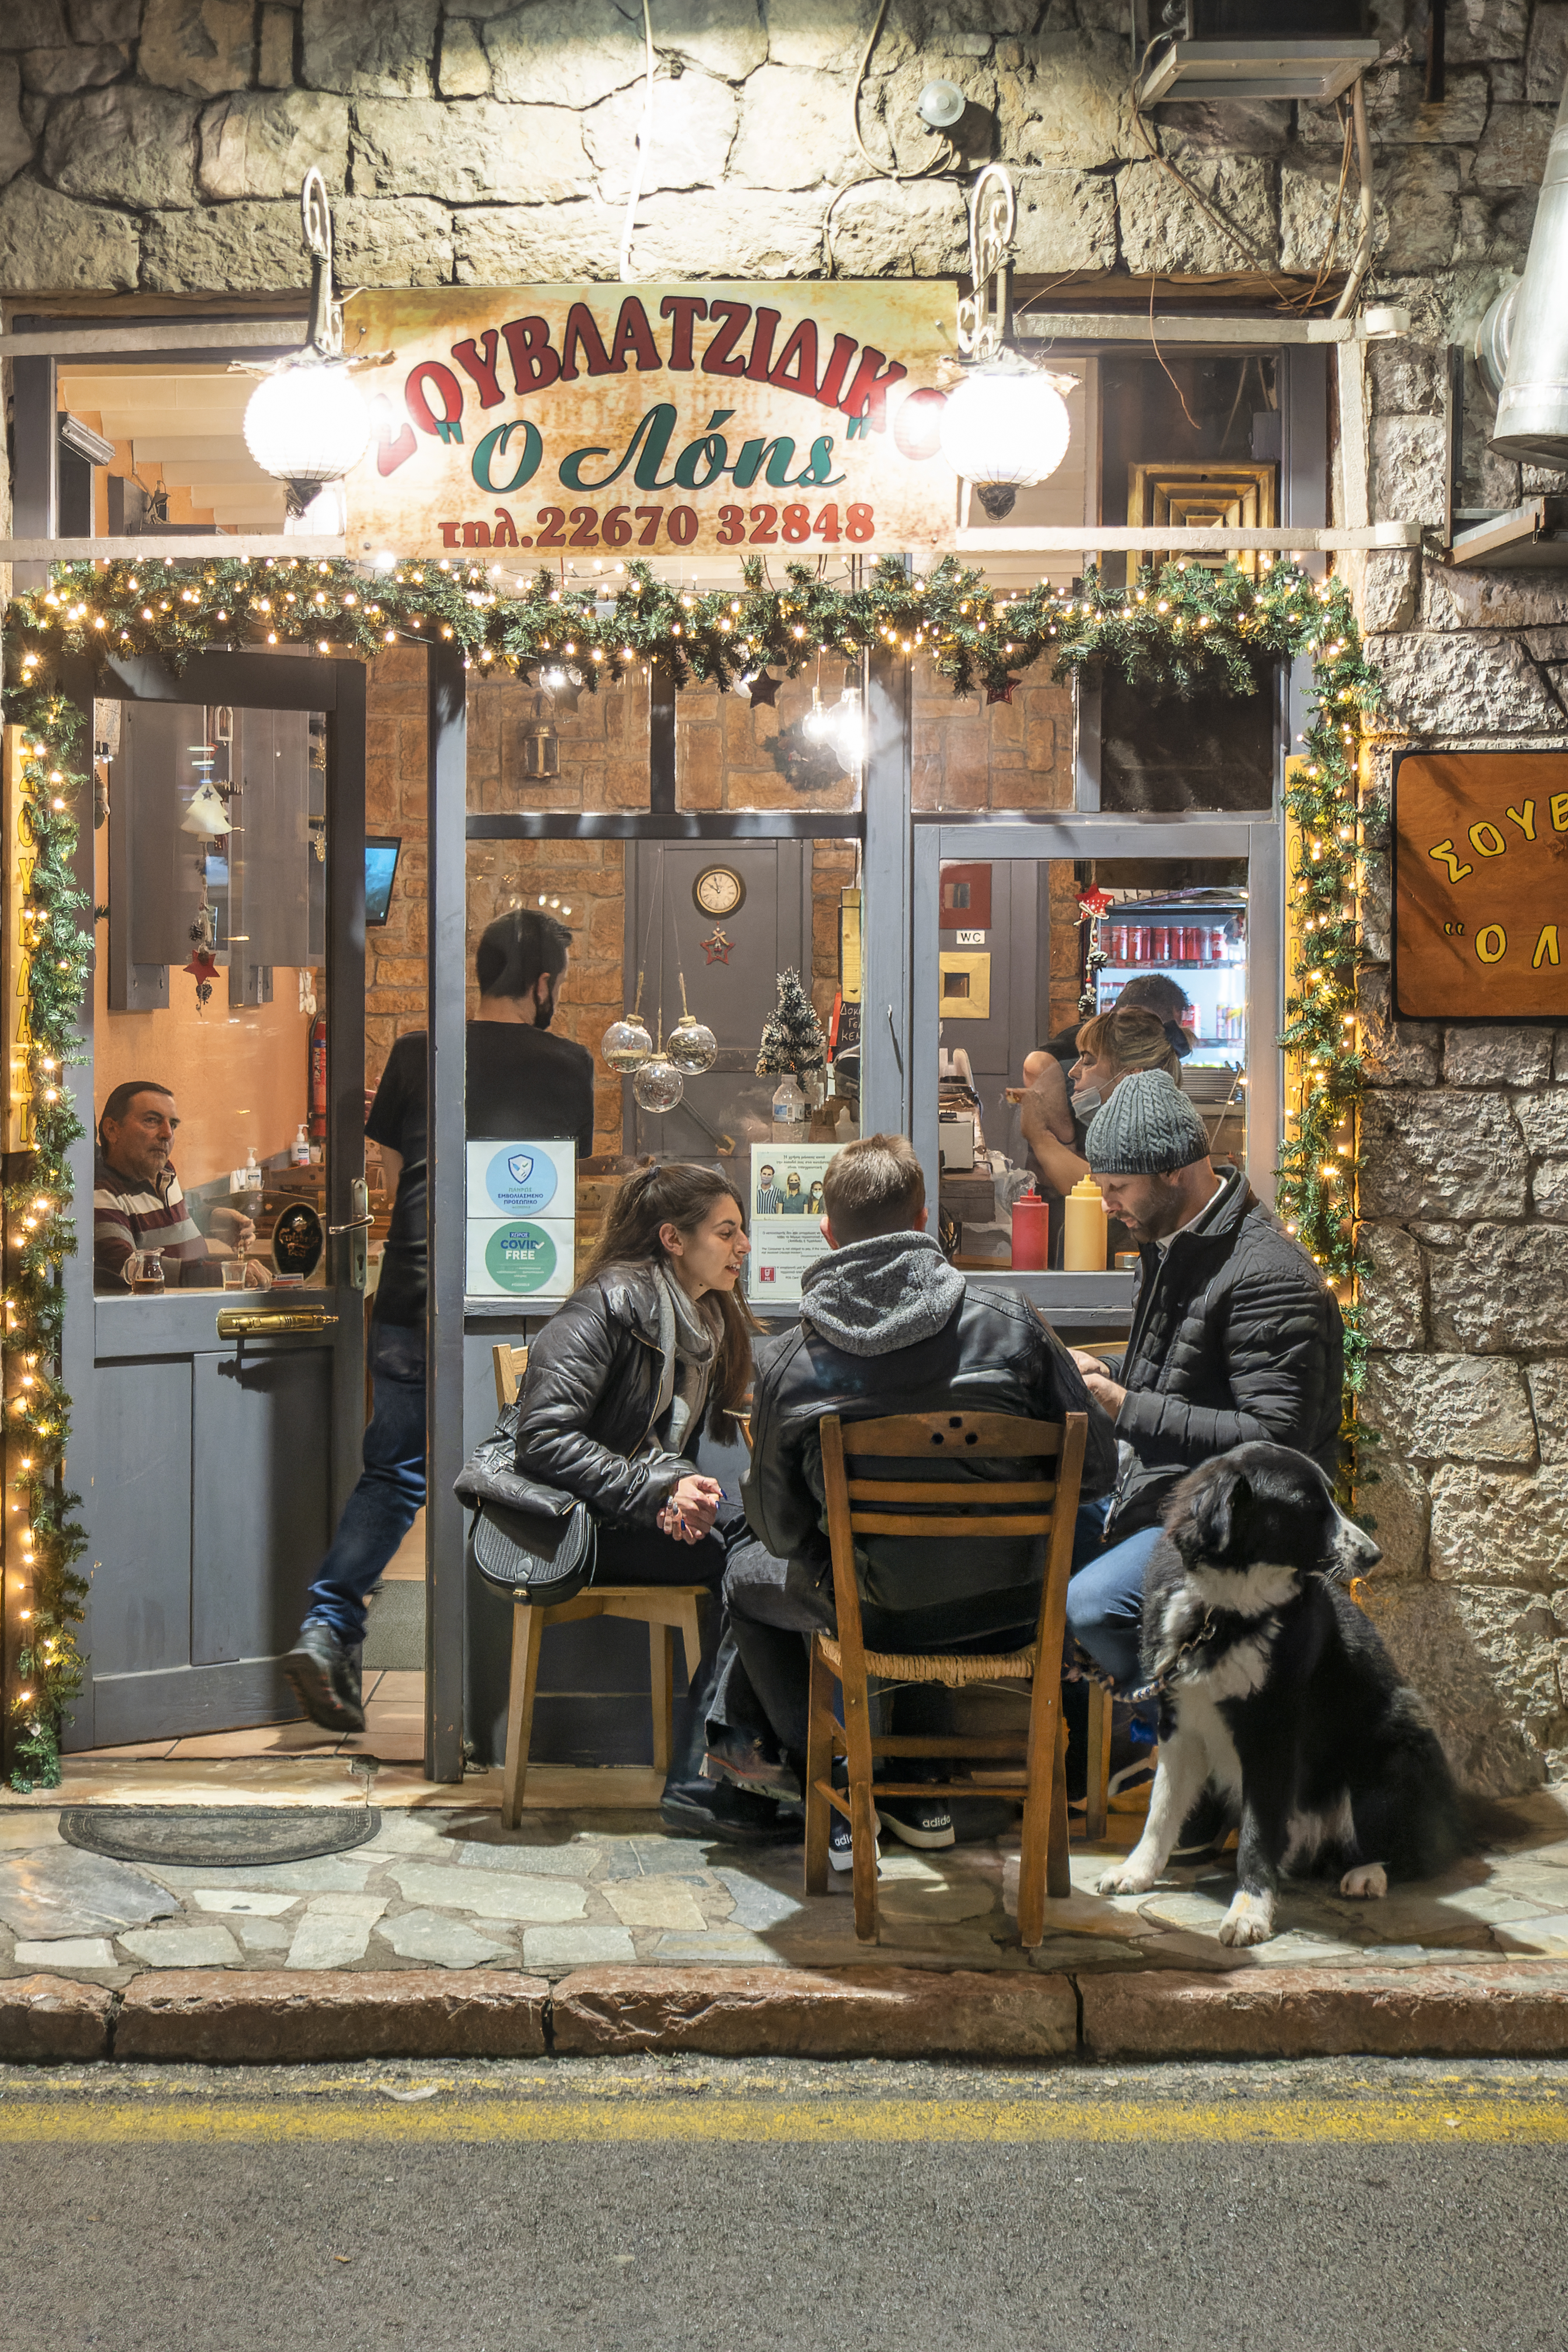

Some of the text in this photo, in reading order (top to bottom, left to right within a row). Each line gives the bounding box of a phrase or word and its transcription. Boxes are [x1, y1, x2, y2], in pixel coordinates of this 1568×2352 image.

[716, 503, 875, 545] 32848
[961, 932, 981, 942] WC
[501, 1240, 539, 1249] COVID
[506, 1250, 535, 1260] FREE
